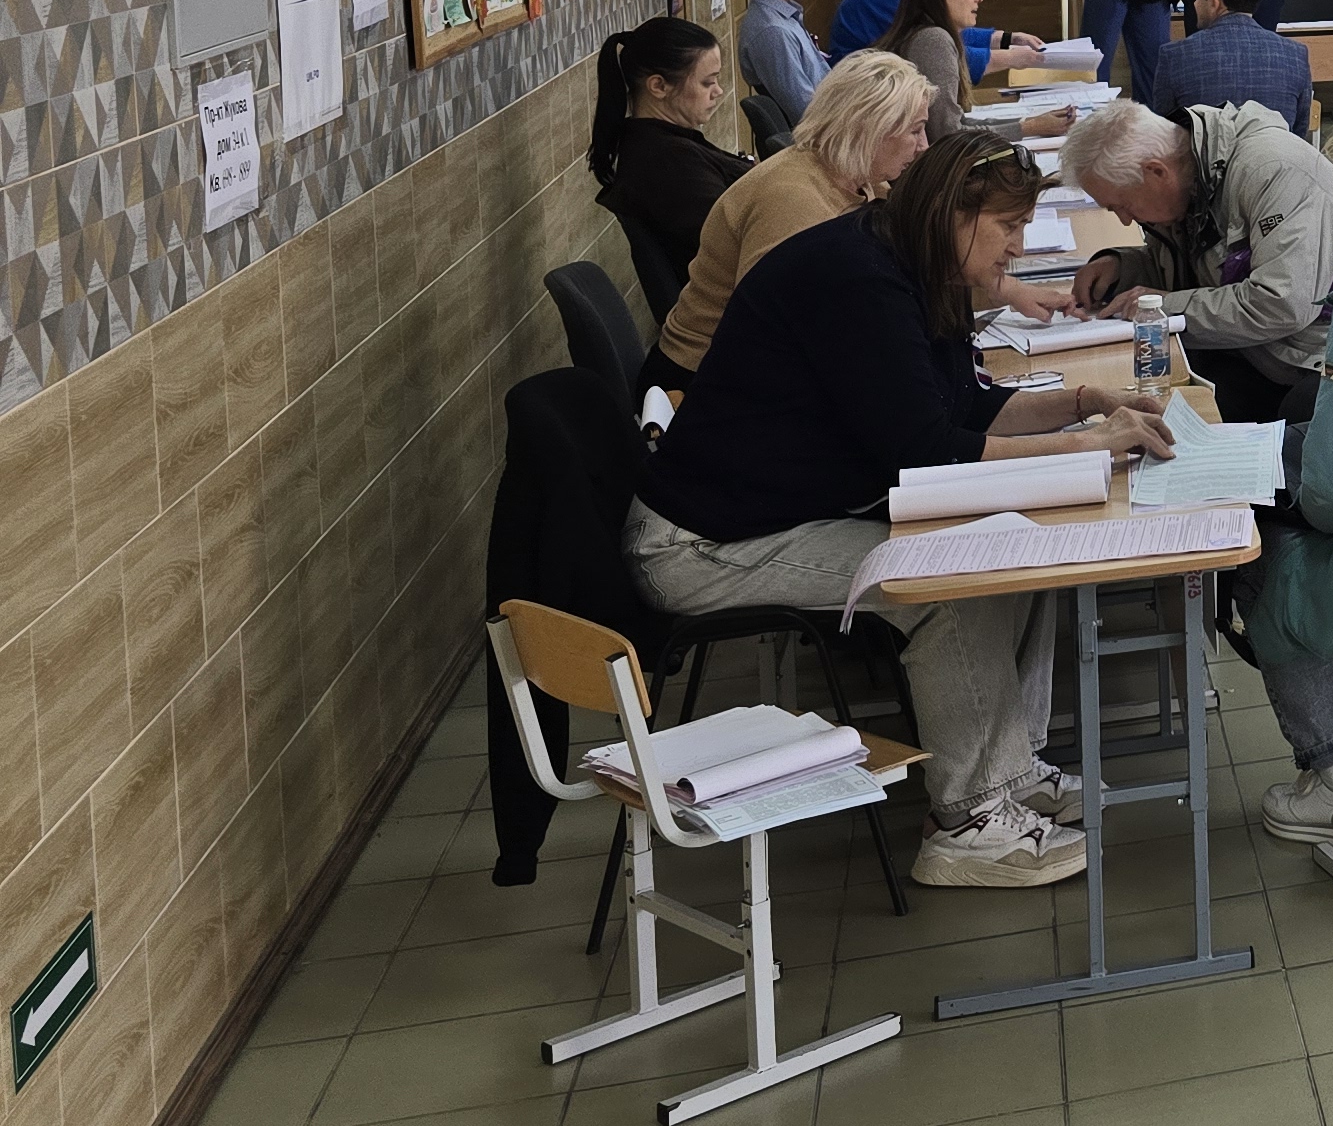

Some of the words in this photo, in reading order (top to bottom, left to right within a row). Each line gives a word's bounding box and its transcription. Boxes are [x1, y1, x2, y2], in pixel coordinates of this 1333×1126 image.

[204, 105, 224, 128] Пр-кт
[223, 98, 248, 122] Жукова
[216, 136, 231, 162] дом
[209, 173, 221, 194] Кв.
